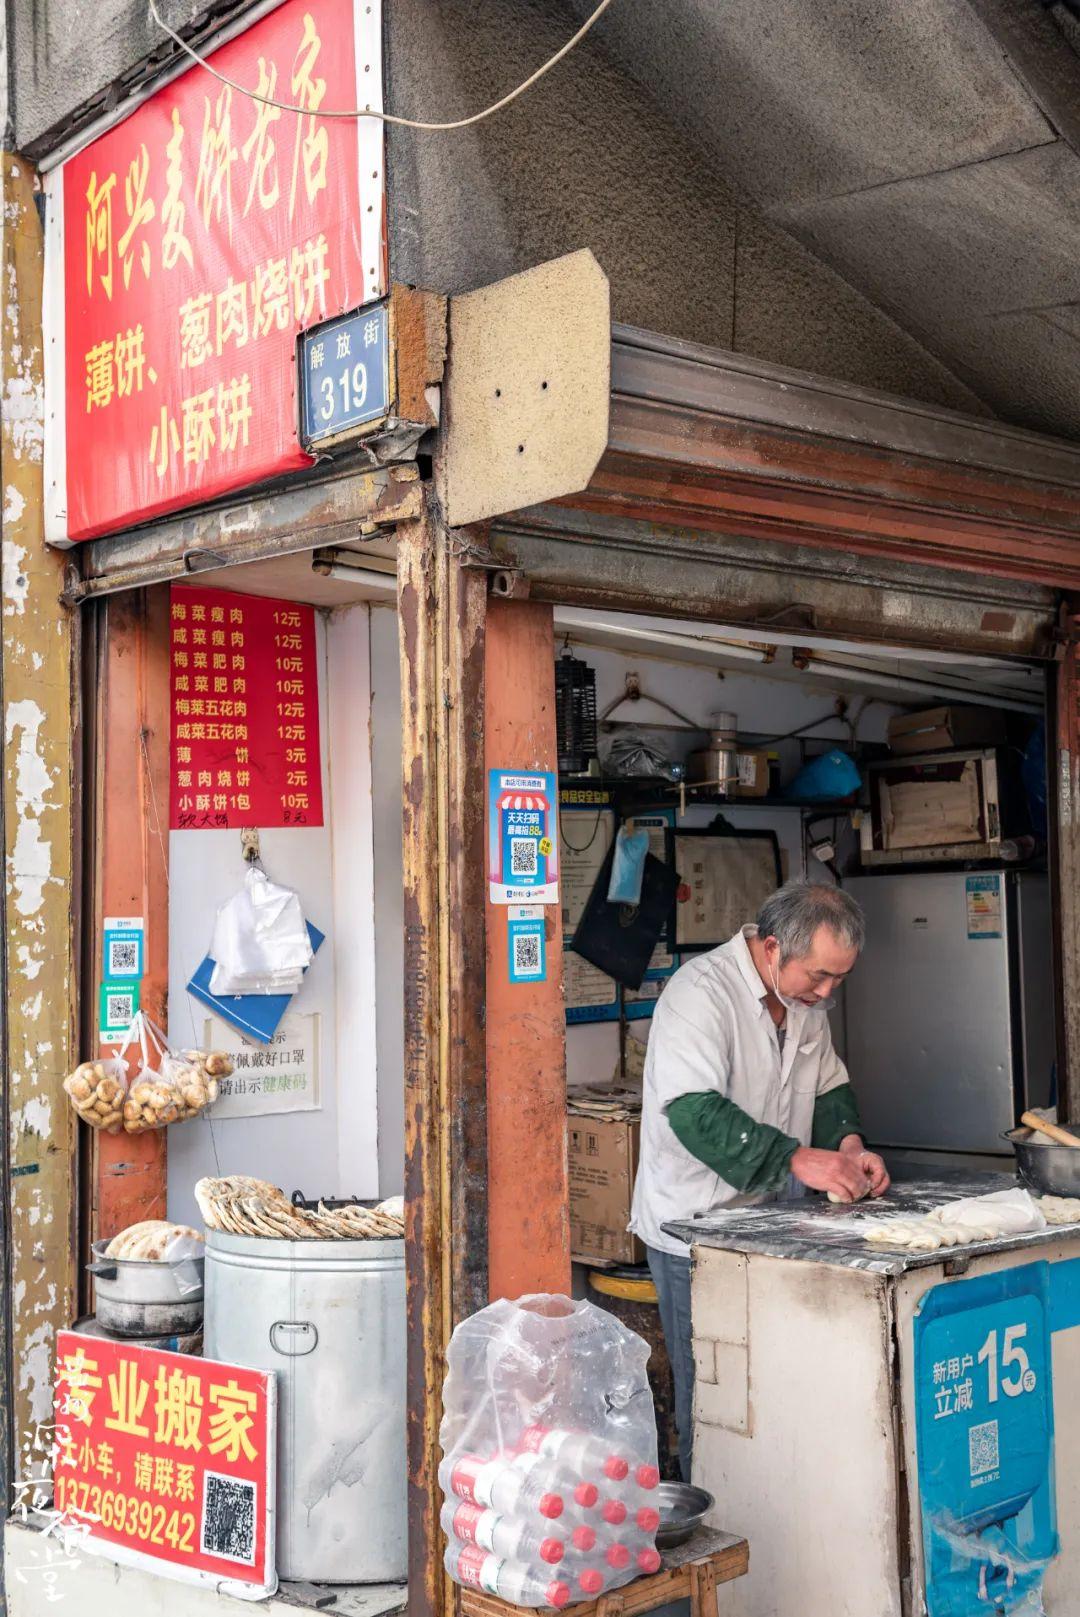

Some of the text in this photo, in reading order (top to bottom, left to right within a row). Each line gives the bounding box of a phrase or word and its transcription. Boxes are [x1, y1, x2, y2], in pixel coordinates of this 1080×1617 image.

[180, 234, 330, 370] 葱肉烧饼
[310, 319, 379, 370] 解放街
[321, 363, 367, 420] 319
[149, 373, 252, 478] 小酥饼
[273, 611, 301, 627] 12元
[274, 634, 302, 650] 12元
[276, 657, 304, 673] 10元
[276, 680, 304, 696] 10元
[176, 699, 305, 718] 梅菜五花肉 12元
[177, 724, 306, 741] 咸菜五花肉 12元
[286, 748, 307, 764] 3元
[287, 771, 308, 787] 2元
[281, 794, 309, 810] 10元
[219, 1073, 307, 1096] 请出示健康码
[932, 1353, 974, 1385] 新用户
[60, 1348, 259, 1463] 专业搬家
[933, 1377, 974, 1421] 立减
[57, 1475, 196, 1553] 13736939242
